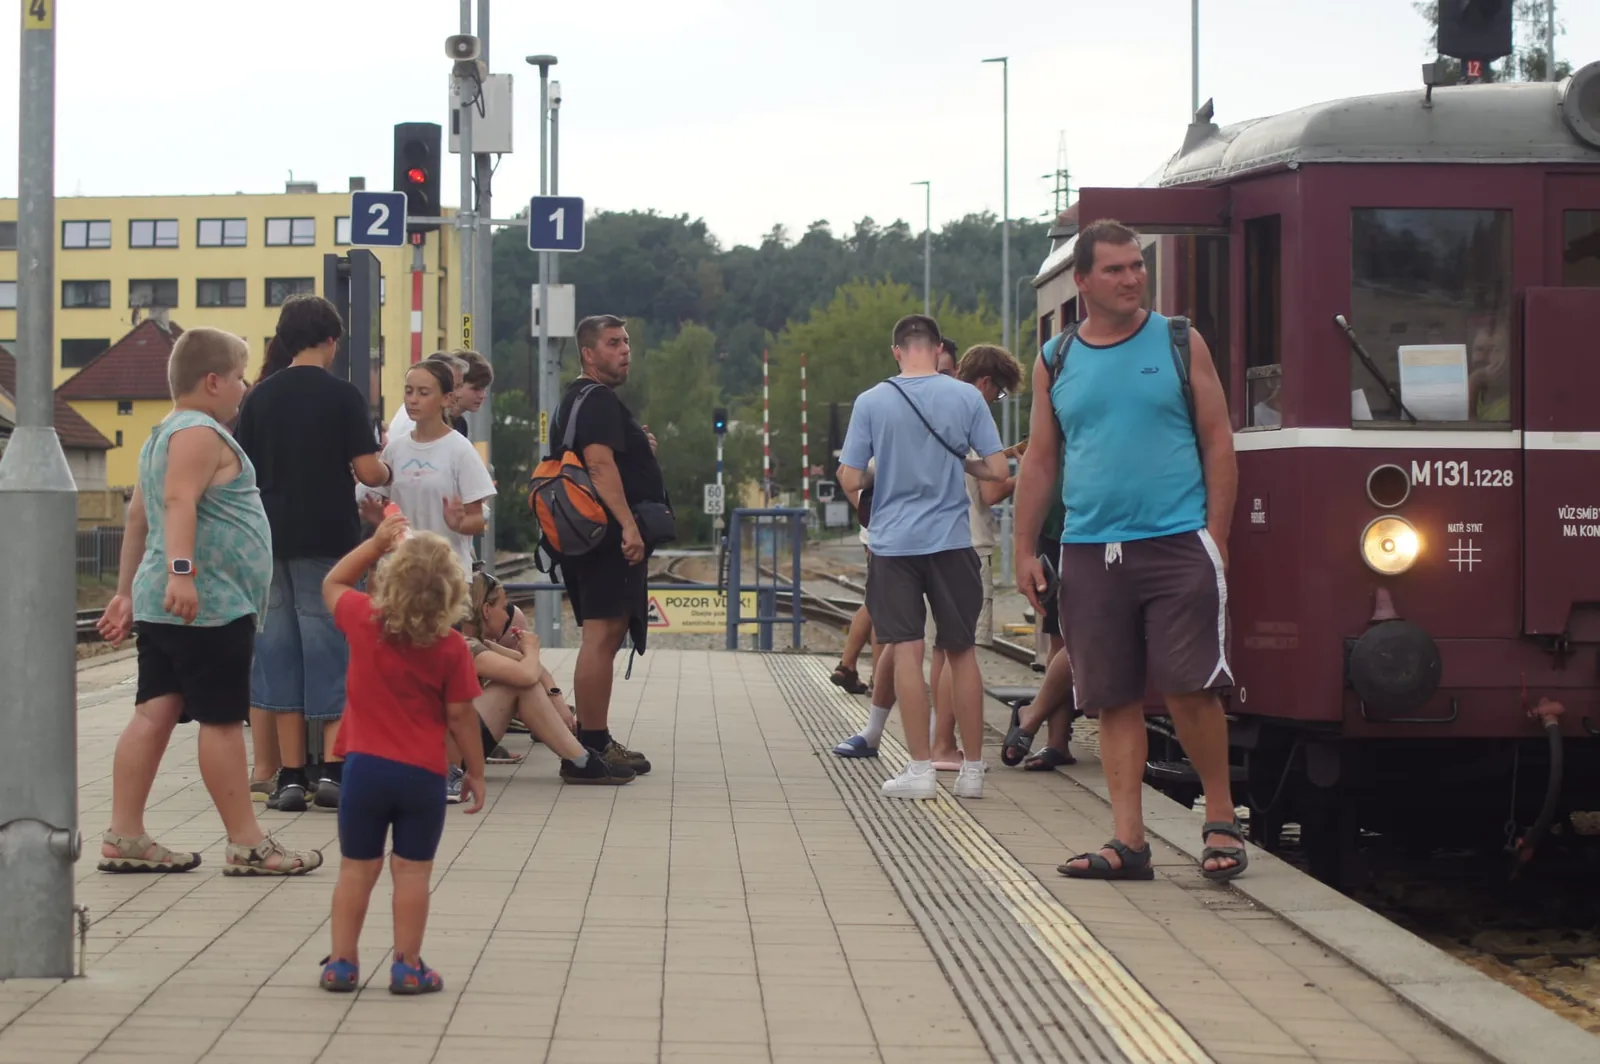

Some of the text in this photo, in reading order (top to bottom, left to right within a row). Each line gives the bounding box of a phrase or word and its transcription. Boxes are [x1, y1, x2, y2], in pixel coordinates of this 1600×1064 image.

[366, 202, 390, 236] 2
[548, 207, 565, 240] 1
[708, 486, 721, 498] 60
[708, 500, 721, 512] 55
[1563, 524, 1578, 537] NA
[665, 597, 751, 608] POZOR VLK!
